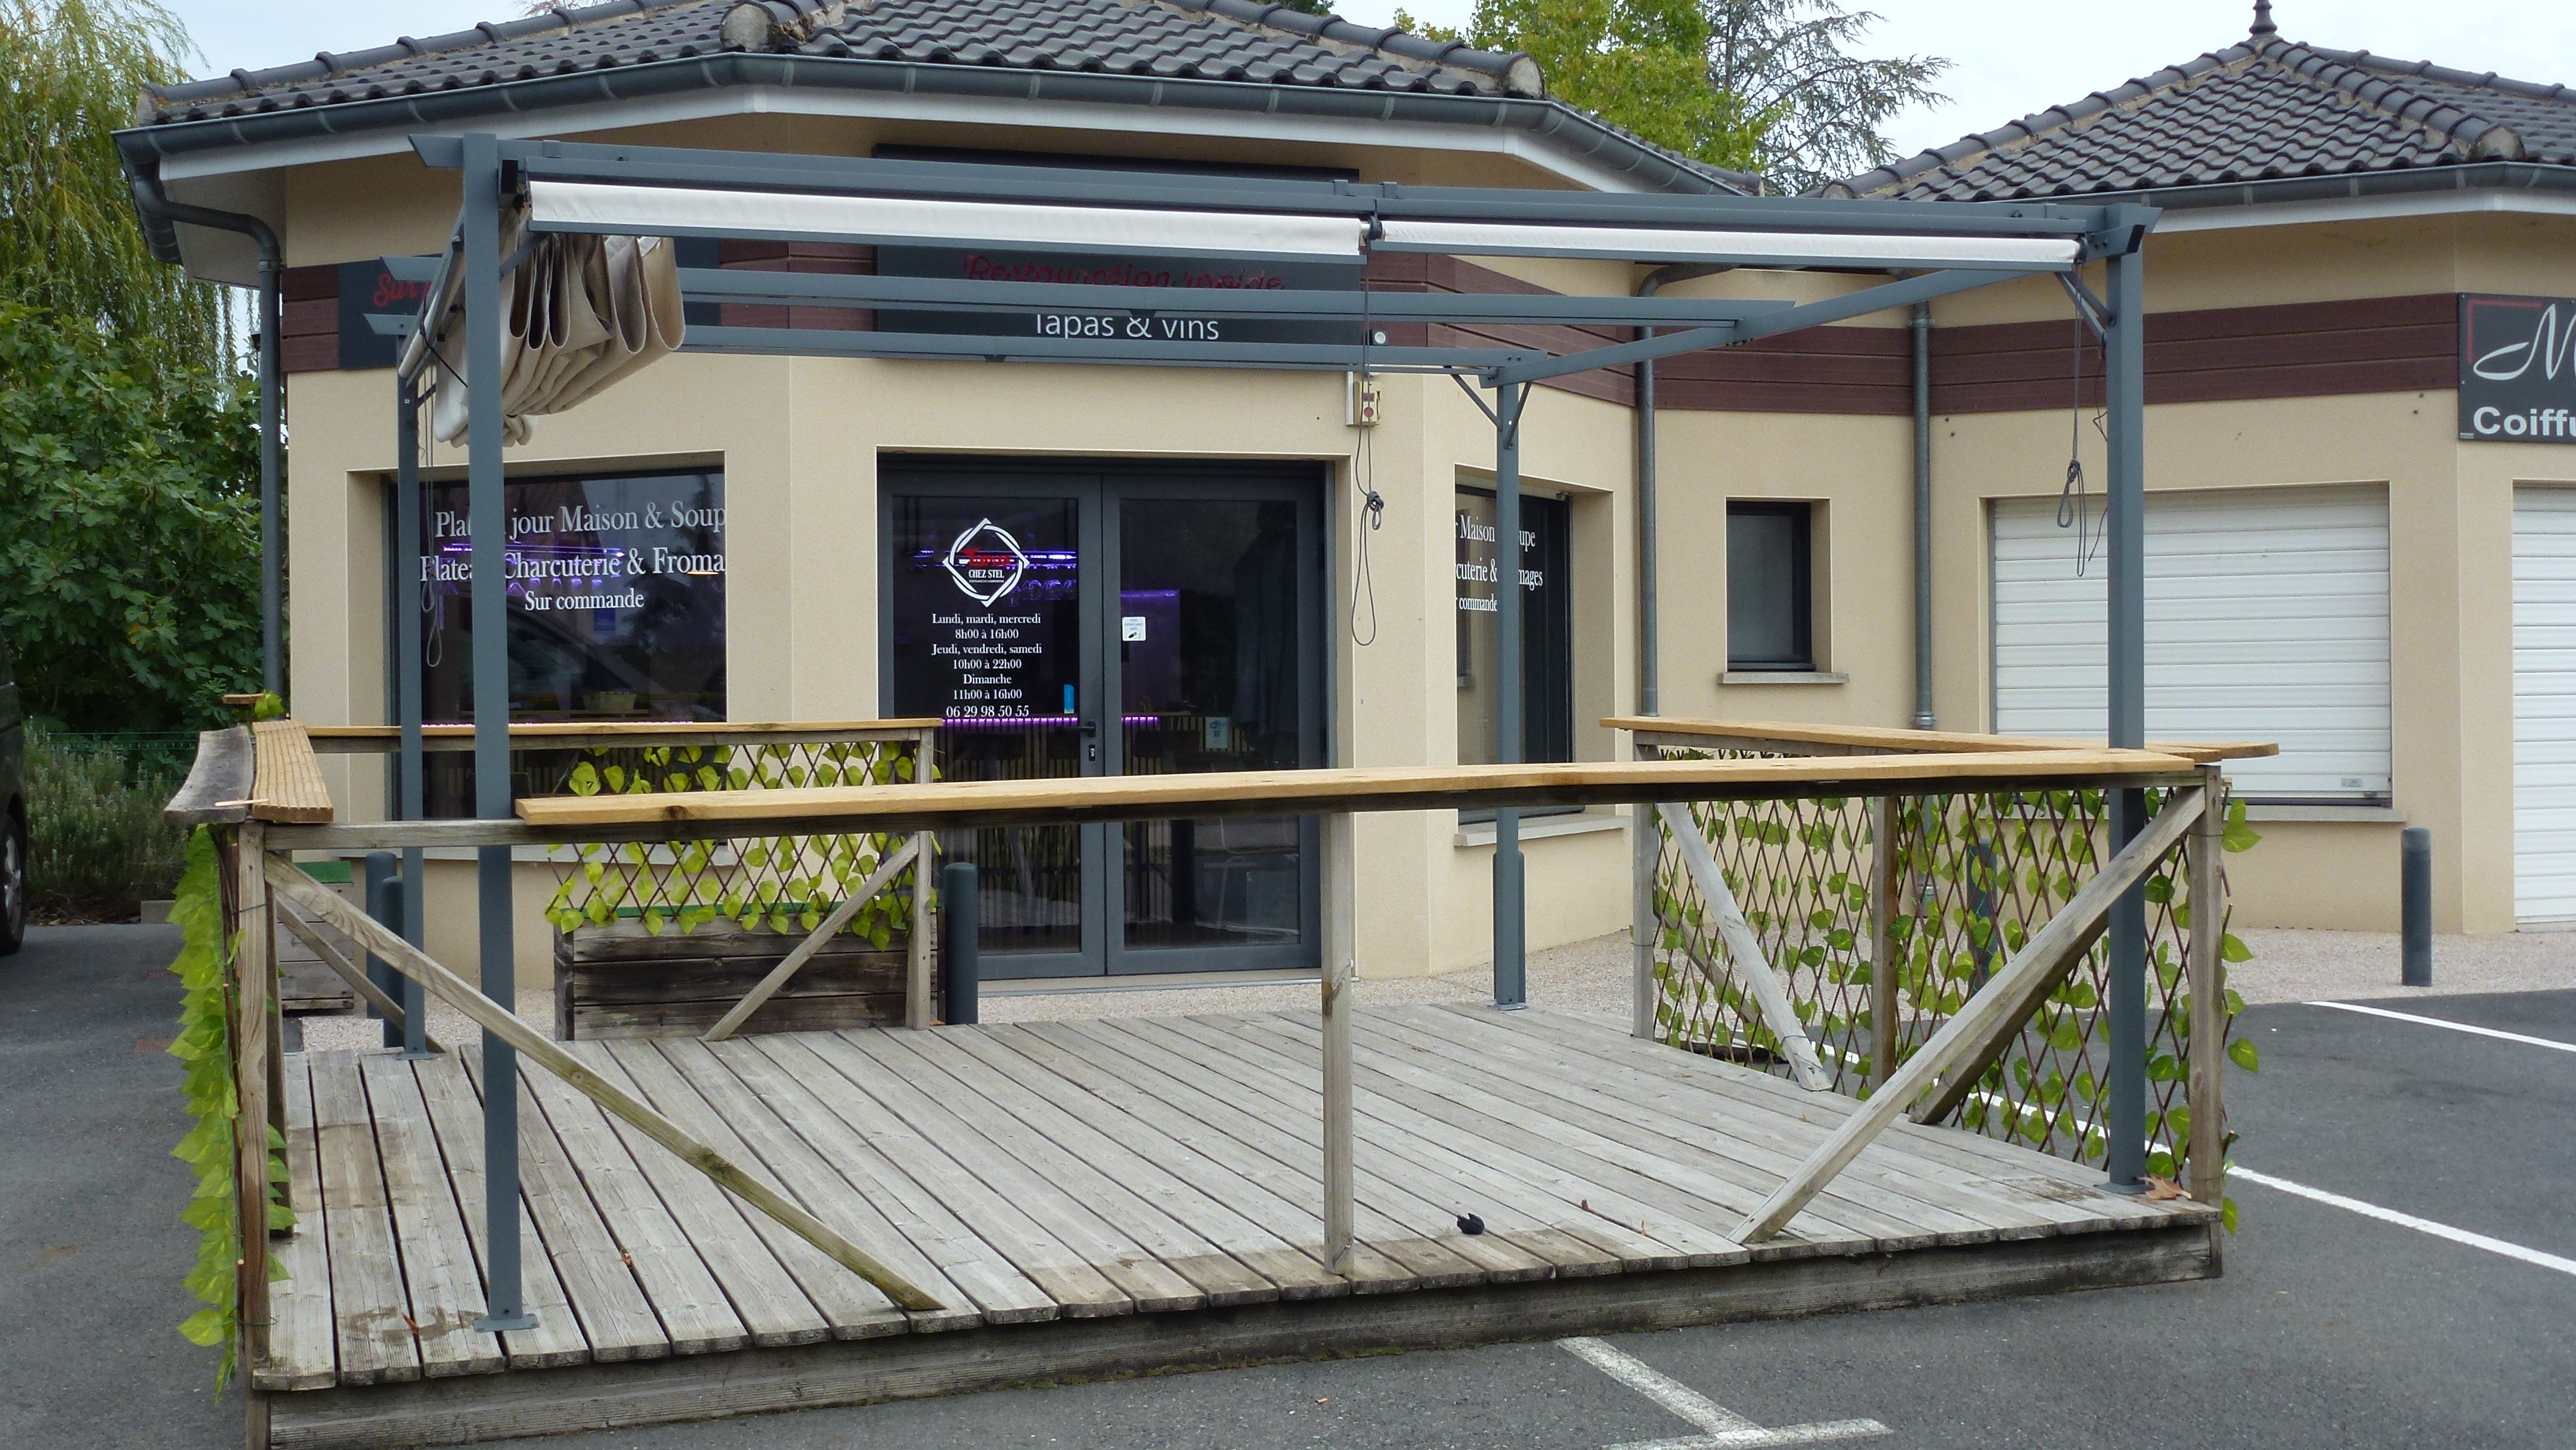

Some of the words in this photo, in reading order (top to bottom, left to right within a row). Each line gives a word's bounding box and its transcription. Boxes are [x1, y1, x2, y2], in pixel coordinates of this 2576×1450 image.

[1162, 319, 1219, 340] vins
[509, 508, 554, 540] jour
[559, 504, 639, 532] Maison
[645, 501, 665, 529] &
[671, 500, 726, 533] Soup
[1460, 515, 1496, 542] Maison
[1519, 529, 1535, 552] upe
[505, 549, 621, 579] Charcuterie
[627, 548, 646, 575] &
[652, 547, 726, 574] Froma
[968, 569, 986, 578] CHEZ
[987, 569, 1005, 578] STEL
[1456, 557, 1488, 581] cuterie
[1518, 569, 1543, 591] mages
[525, 590, 552, 611] Sur
[556, 588, 645, 609] commande
[1459, 593, 1497, 612] commande
[931, 613, 964, 625] Lundi,
[966, 613, 997, 625] mardi,
[999, 613, 1041, 624] mercredi
[955, 628, 979, 639] 8h00
[982, 630, 987, 639] à
[990, 628, 1019, 639] 16h00
[931, 643, 961, 655] Jeudi,
[962, 643, 1007, 655] vendredi,
[1009, 643, 1042, 653] samedi
[953, 659, 982, 669] 10h00
[984, 660, 990, 669] à
[992, 659, 1021, 669] 22h00
[963, 674, 1012, 684] Dimanche
[954, 689, 982, 699] 11h00
[984, 690, 990, 699] à
[993, 689, 1022, 699] 16h00
[946, 706, 960, 718] 06
[964, 706, 977, 717] 29
[980, 706, 995, 717] 98
[998, 705, 1012, 717] 50
[1015, 705, 1029, 717] 55
